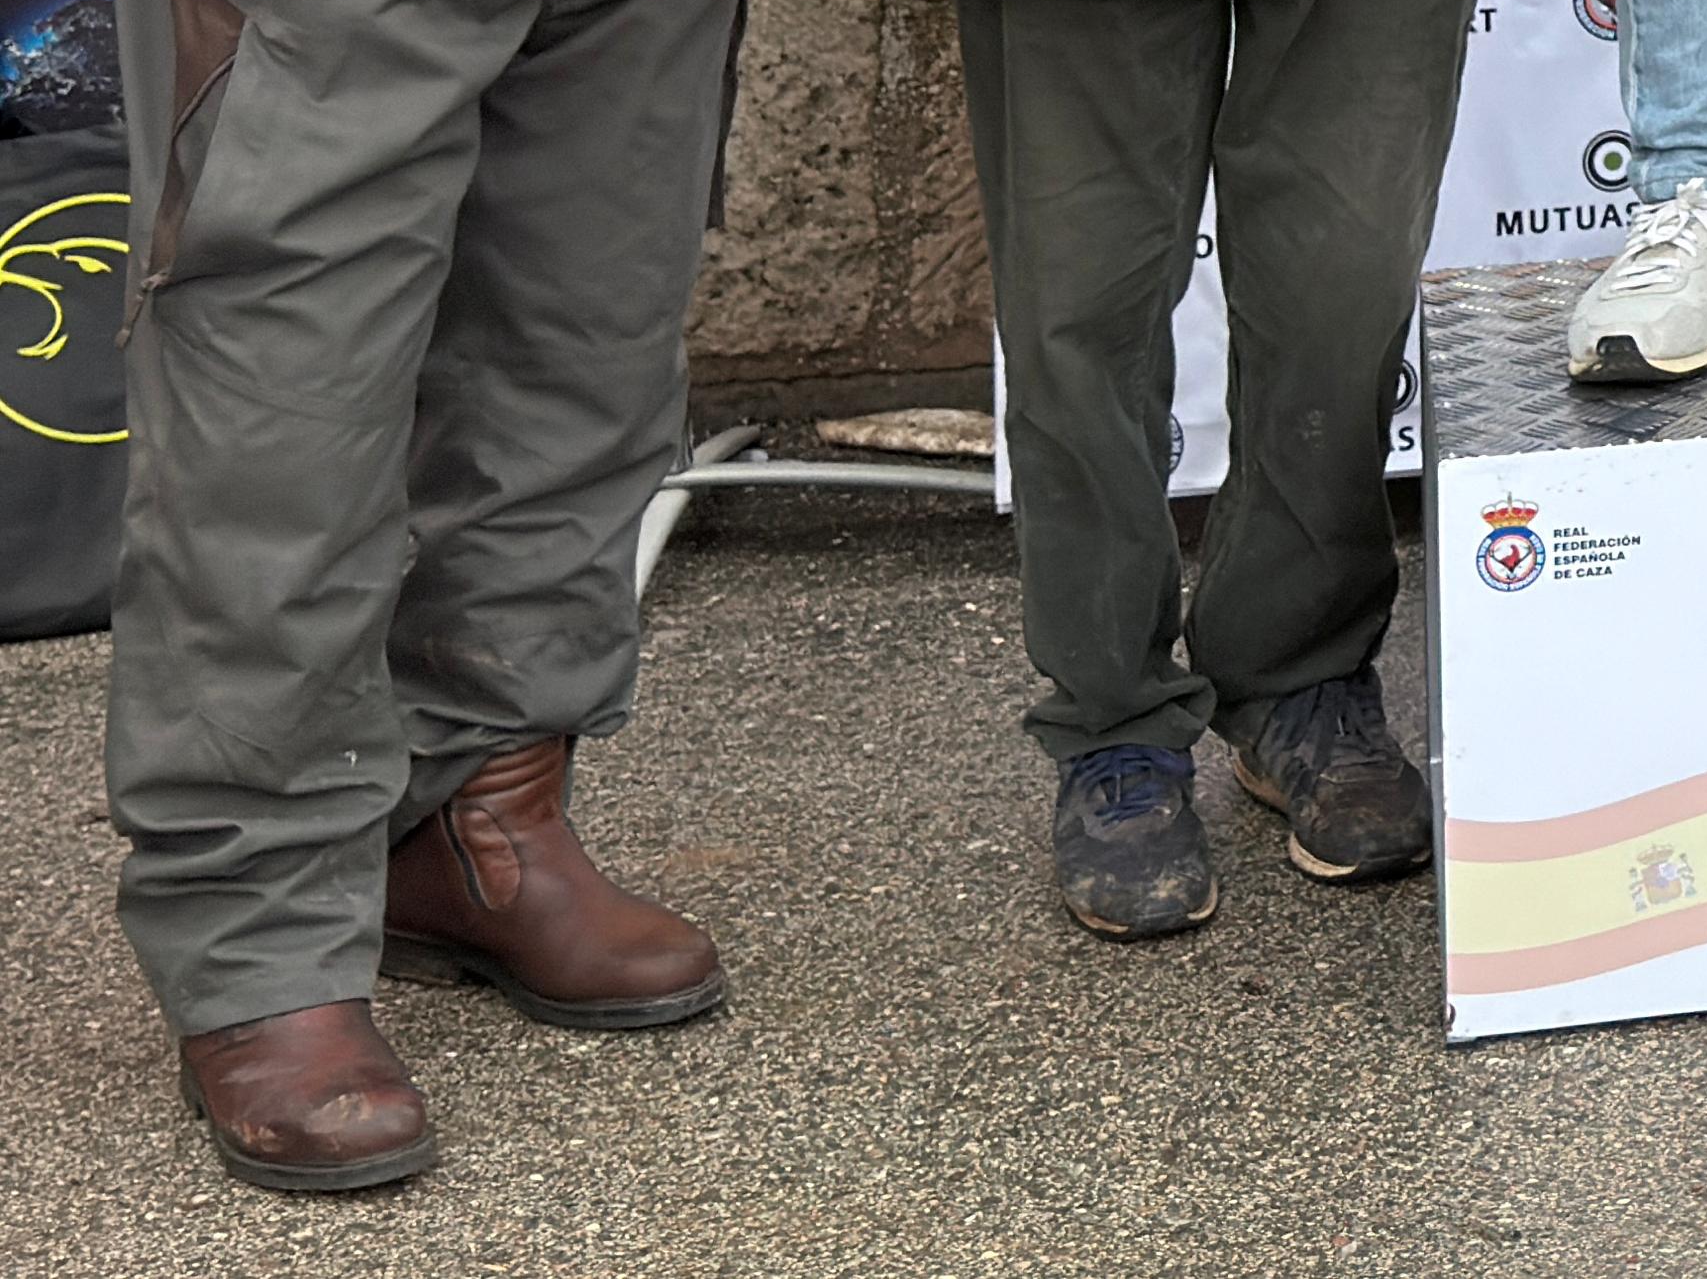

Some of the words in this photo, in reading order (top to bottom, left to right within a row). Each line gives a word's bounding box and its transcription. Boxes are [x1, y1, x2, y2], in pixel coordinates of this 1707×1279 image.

[1553, 527, 1589, 538] REAL
[1553, 535, 1641, 553] FEDERACIÓN
[1554, 551, 1626, 566] ESPAÑOLA
[1554, 570, 1572, 580] DE
[1576, 566, 1613, 578] CAZA
